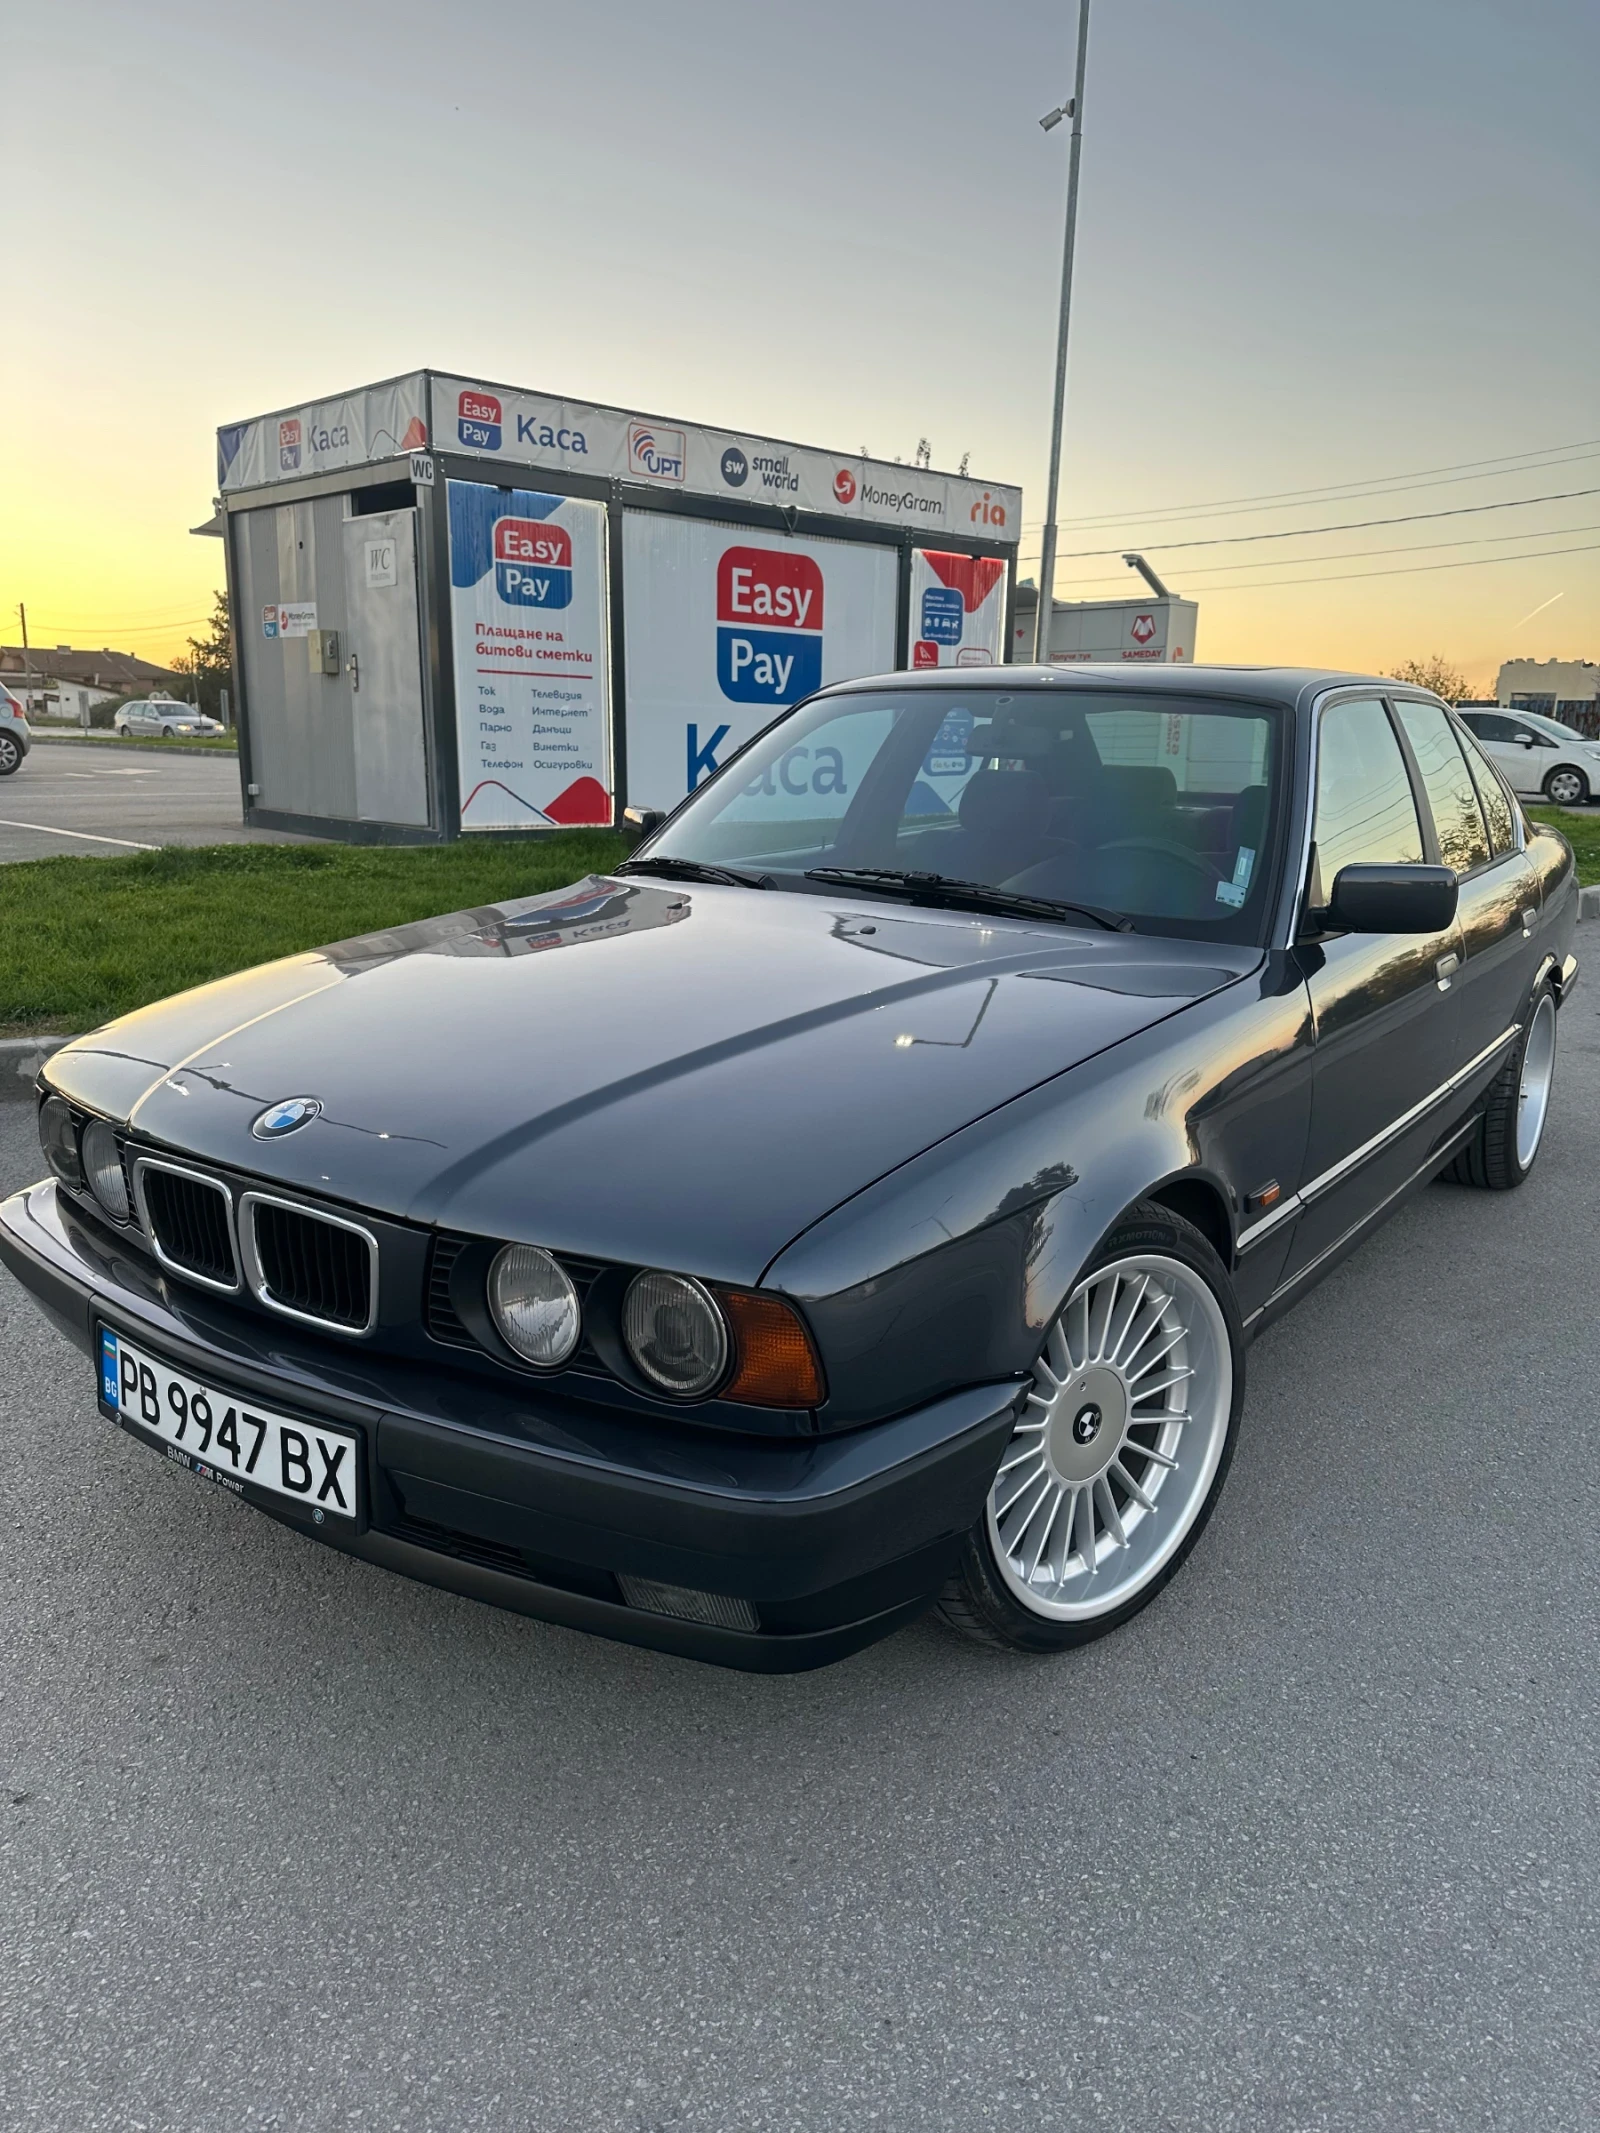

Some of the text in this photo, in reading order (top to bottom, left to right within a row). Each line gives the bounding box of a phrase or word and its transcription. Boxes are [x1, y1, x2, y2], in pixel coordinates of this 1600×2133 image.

[463, 398, 497, 422] Easy
[307, 425, 349, 454] Каса
[463, 423, 490, 446] Pay
[517, 414, 588, 454] Каса
[411, 458, 433, 478] WC
[648, 455, 682, 477] UPT
[752, 456, 789, 474] small
[762, 472, 799, 492] world
[860, 484, 943, 514] MoneyGram
[970, 492, 1006, 527] ria
[504, 530, 563, 564] Easy
[370, 548, 390, 571] WC
[505, 569, 550, 601] Pay
[731, 567, 813, 627] Easy
[475, 623, 564, 642] Плащане на
[476, 642, 593, 662] битови сметки
[1121, 650, 1162, 659] SAMEDAY
[731, 638, 795, 696] Pay
[478, 686, 496, 696] Ток
[531, 689, 582, 701] Телевизия
[479, 704, 505, 715] Вода
[480, 722, 512, 733] Парно
[532, 724, 572, 735] Данъци
[480, 741, 496, 751] Газ
[533, 743, 579, 752] Винетки
[481, 759, 523, 769] Телефон
[533, 760, 593, 770] Осигуровки
[104, 1376, 117, 1398] BG
[119, 1349, 348, 1509] PB 9947 BX
[167, 1445, 191, 1468] BMW
[216, 1472, 245, 1493] Power
